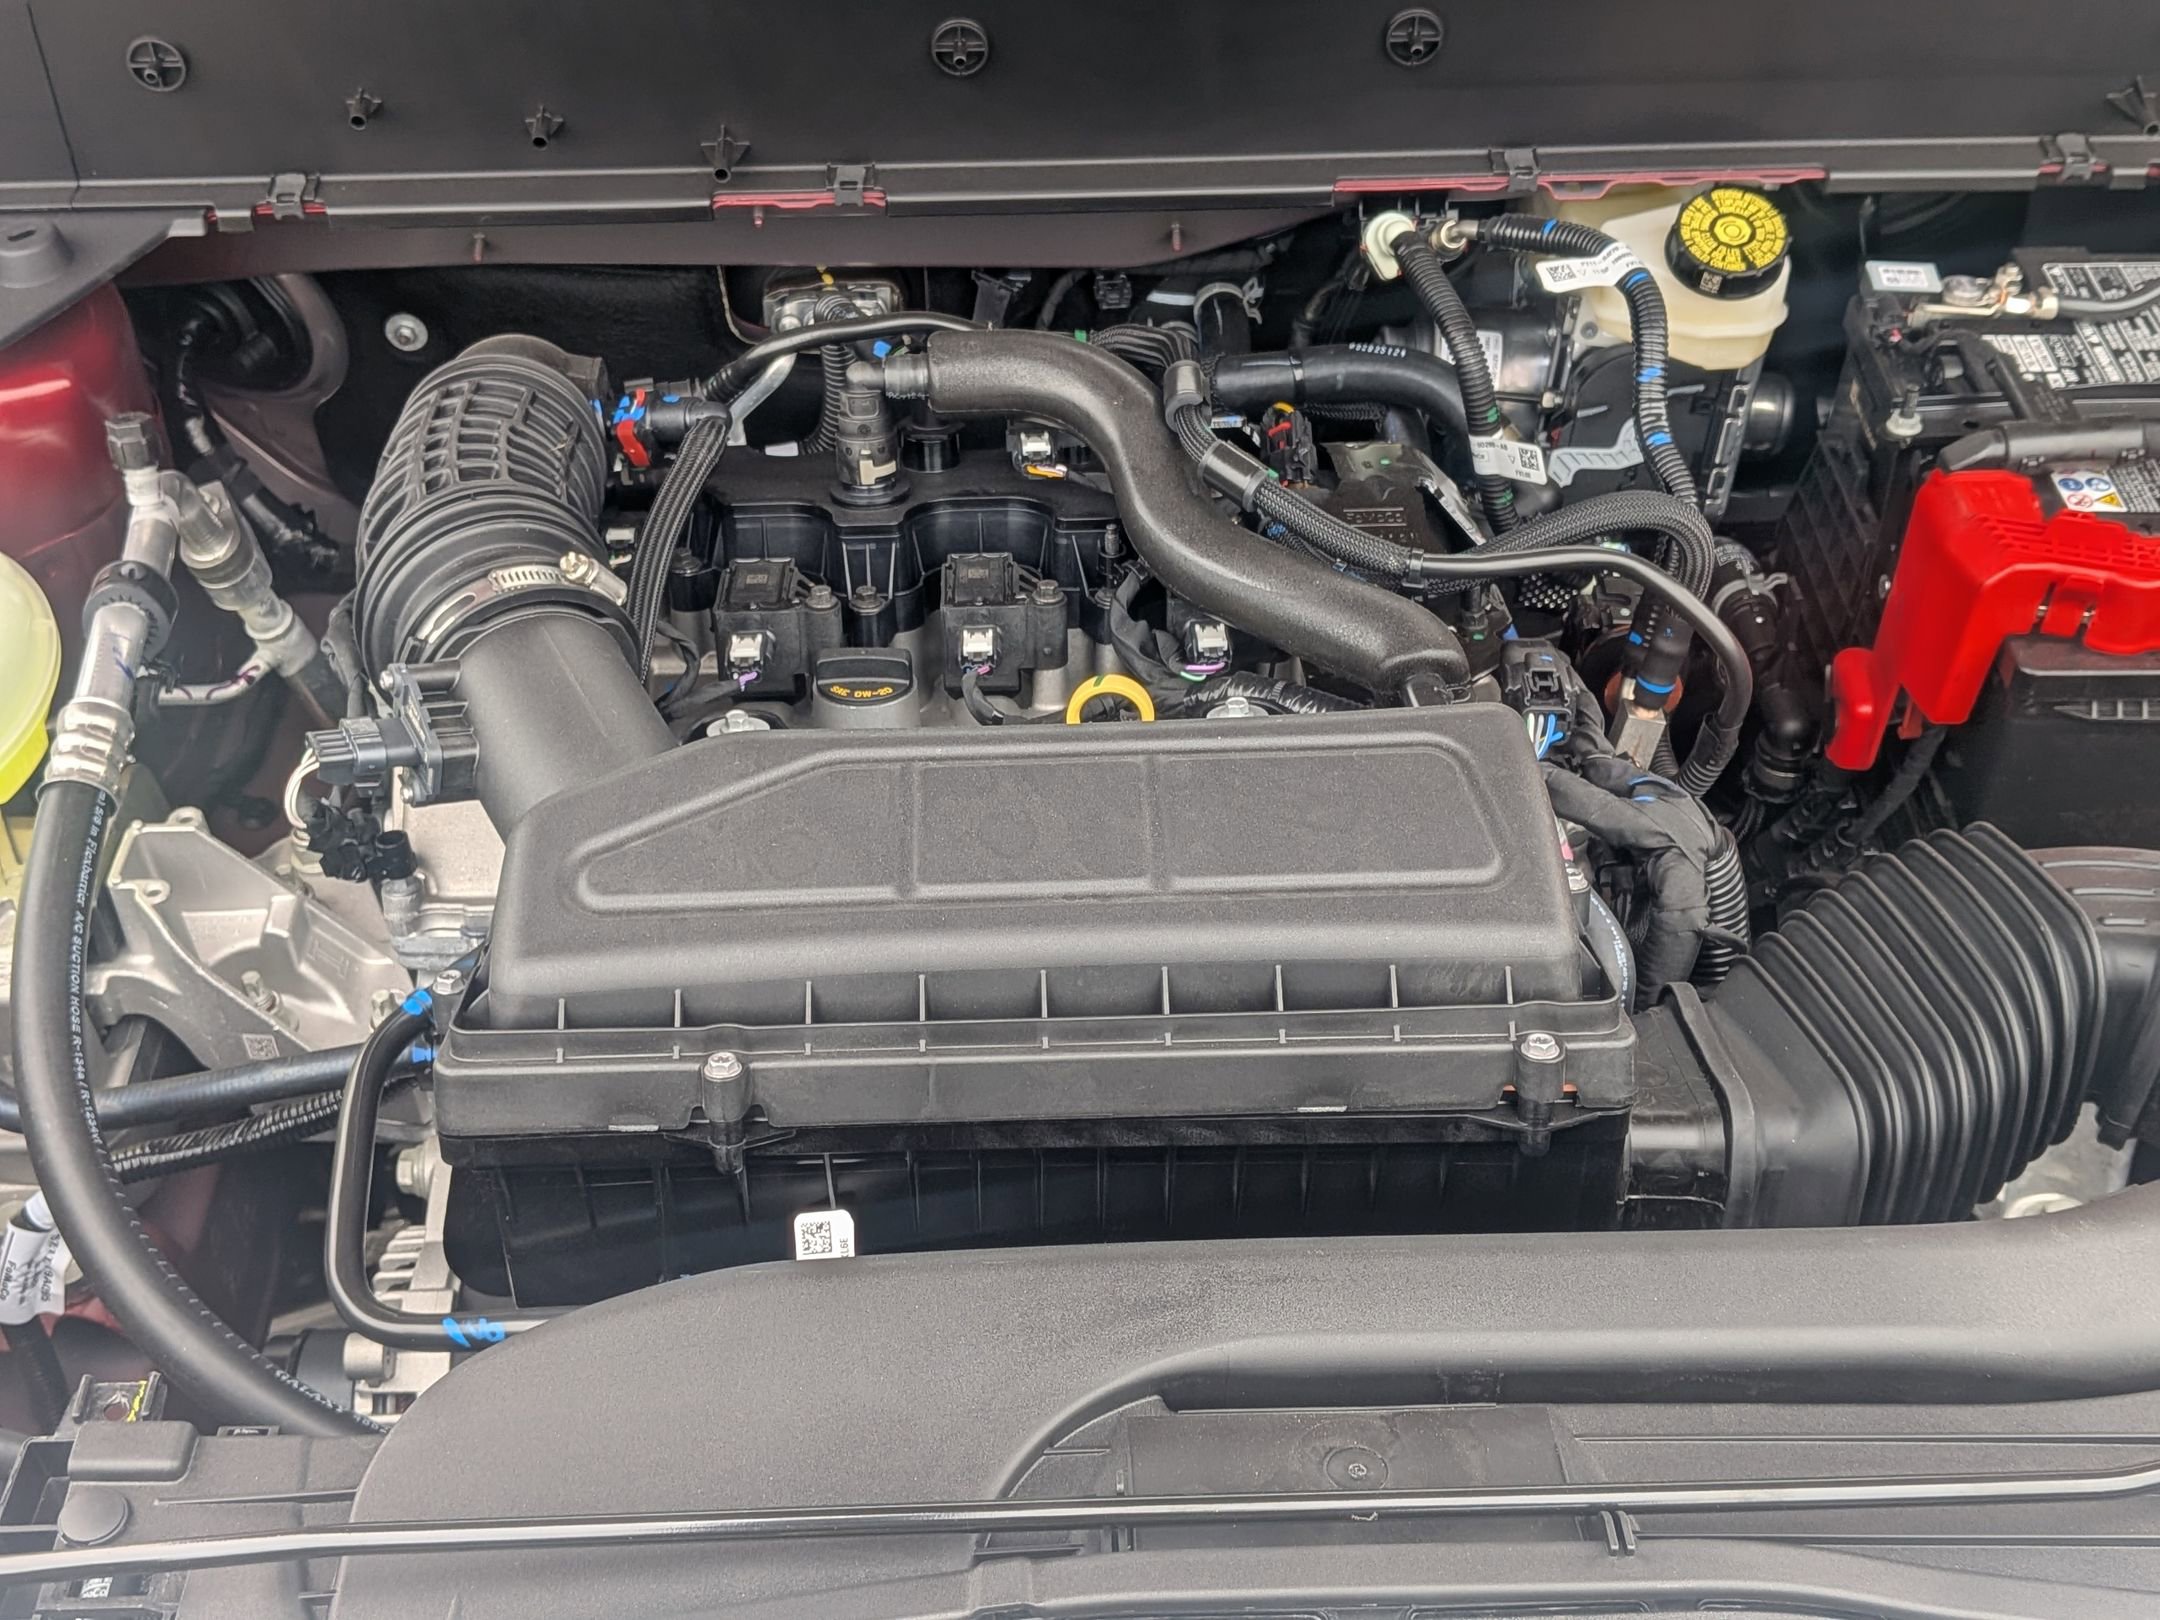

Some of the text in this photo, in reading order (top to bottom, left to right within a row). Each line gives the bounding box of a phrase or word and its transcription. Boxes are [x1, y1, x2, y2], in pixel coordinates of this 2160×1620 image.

[830, 685, 851, 697] SAE
[76, 838, 98, 908] Flexbarrier
[74, 911, 86, 936] A/C
[70, 937, 85, 994] SUCTION
[70, 995, 82, 1032] HOSE
[0, 1260, 17, 1301] FoMoCo
